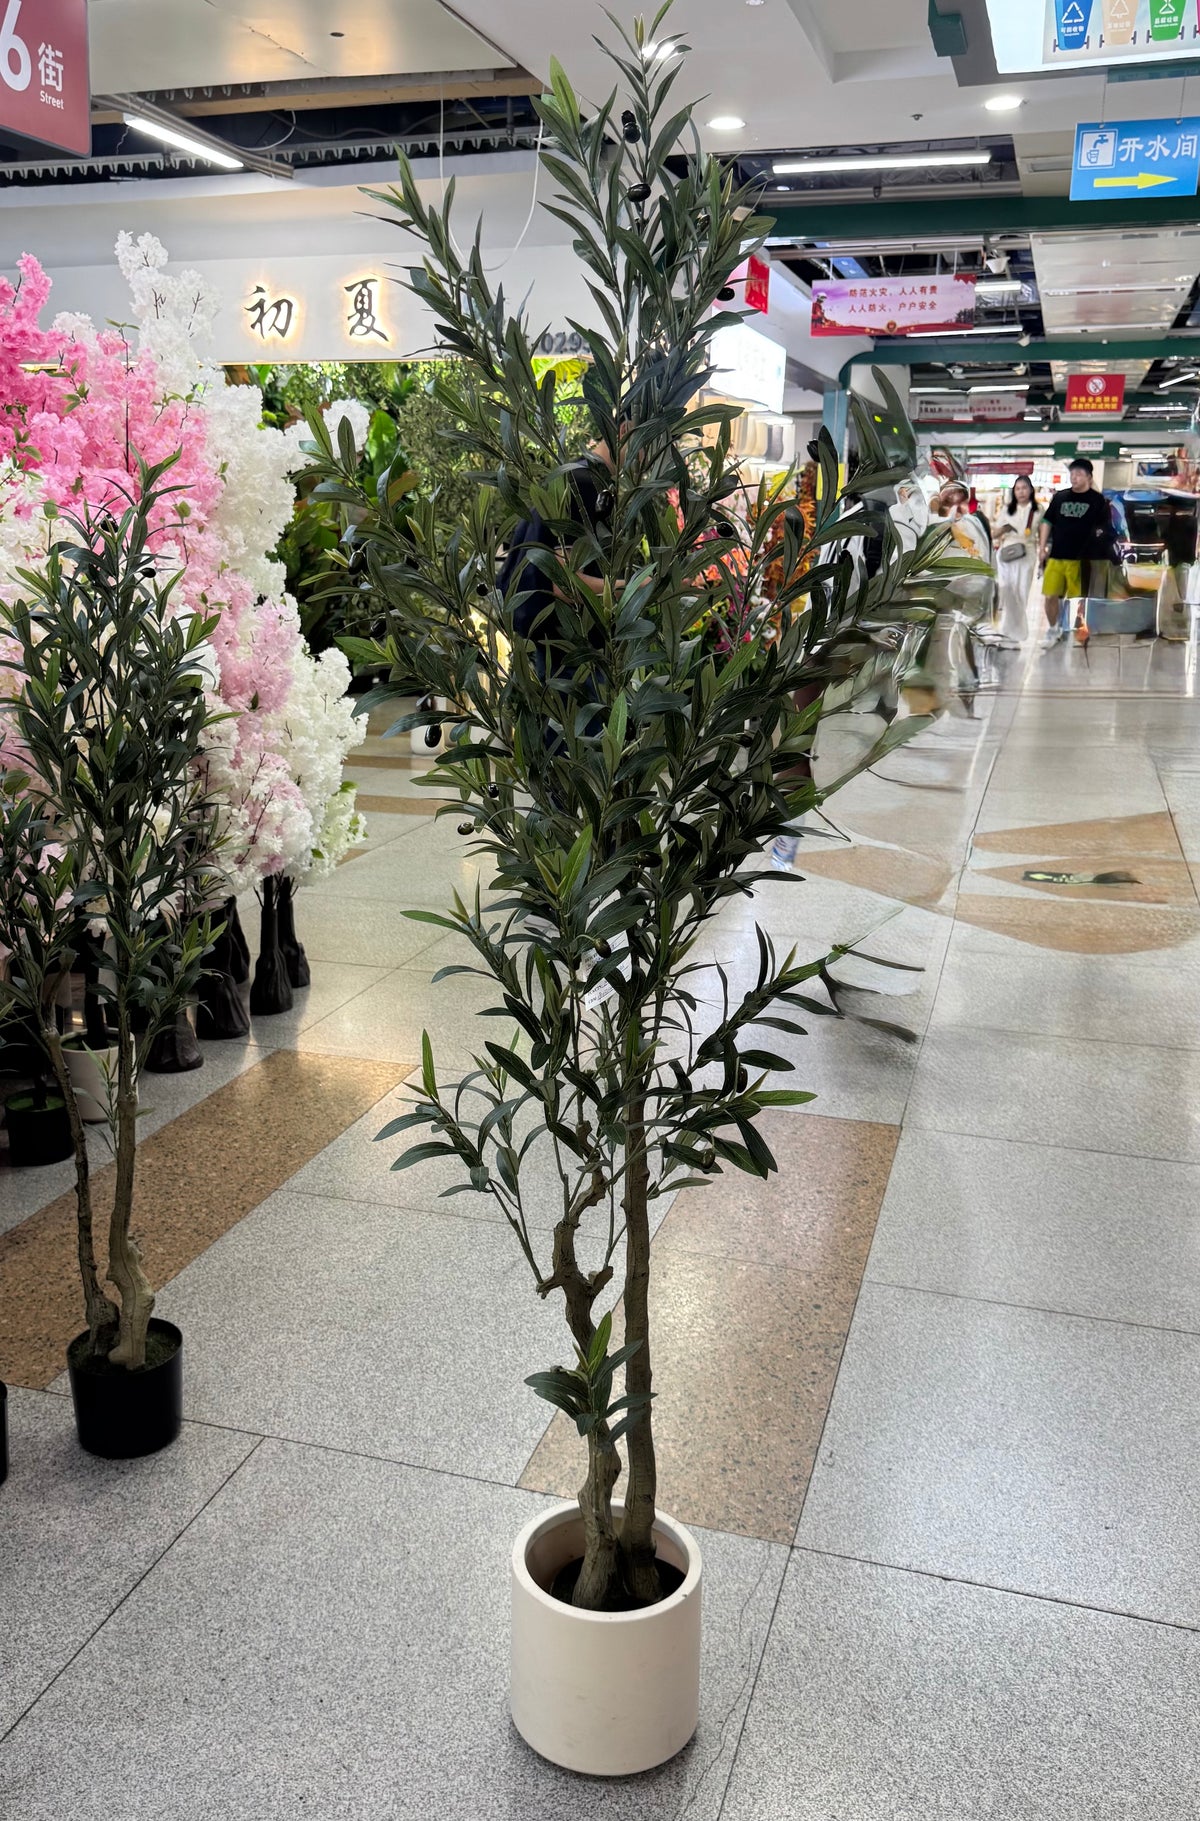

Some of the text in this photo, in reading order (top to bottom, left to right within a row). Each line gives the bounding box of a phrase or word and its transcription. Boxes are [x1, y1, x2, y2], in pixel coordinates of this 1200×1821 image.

[0, 0, 64, 92] 6 街
[40, 90, 64, 110] Street
[1118, 134, 1198, 162] 开水间
[245, 278, 389, 342] 初夏
